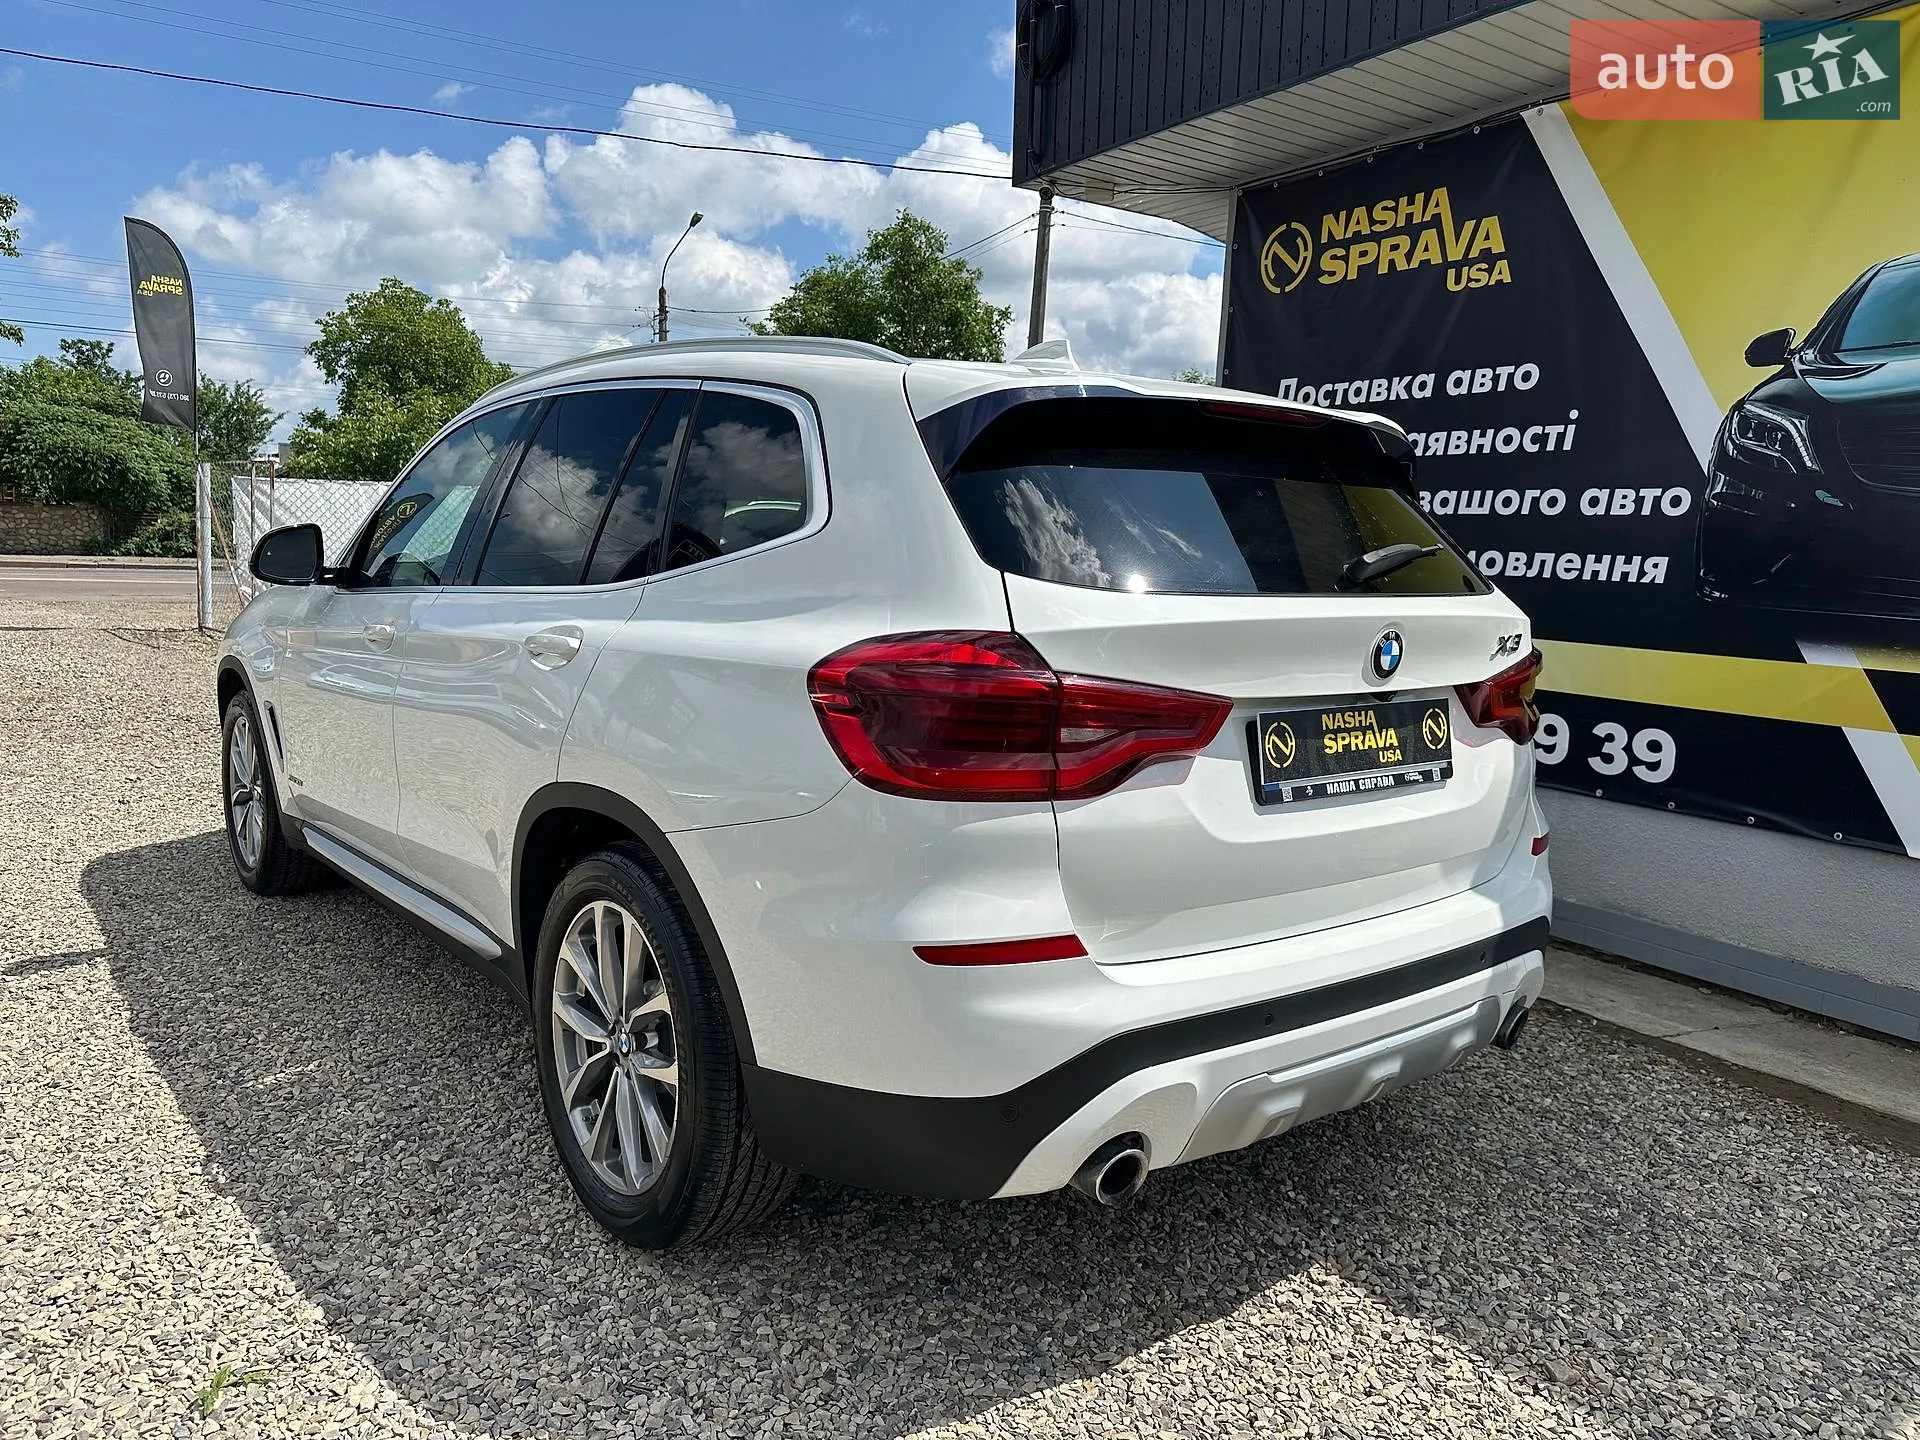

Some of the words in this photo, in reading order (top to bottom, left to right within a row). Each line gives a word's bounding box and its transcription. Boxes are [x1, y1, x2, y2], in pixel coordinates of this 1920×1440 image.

[1320, 186, 1449, 244] NASHA
[1317, 215, 1506, 285] SPRAVA
[1446, 259, 1513, 292] USA
[1446, 362, 1540, 396] авто
[1579, 486, 1692, 517] авто
[1321, 710, 1377, 731] NASHA
[1323, 727, 1399, 755] SPRAVA
[1378, 748, 1403, 764] USA
[1587, 722, 1677, 783] 39
[1326, 780, 1356, 795] НАША
[1359, 775, 1395, 791] СПРАВА
